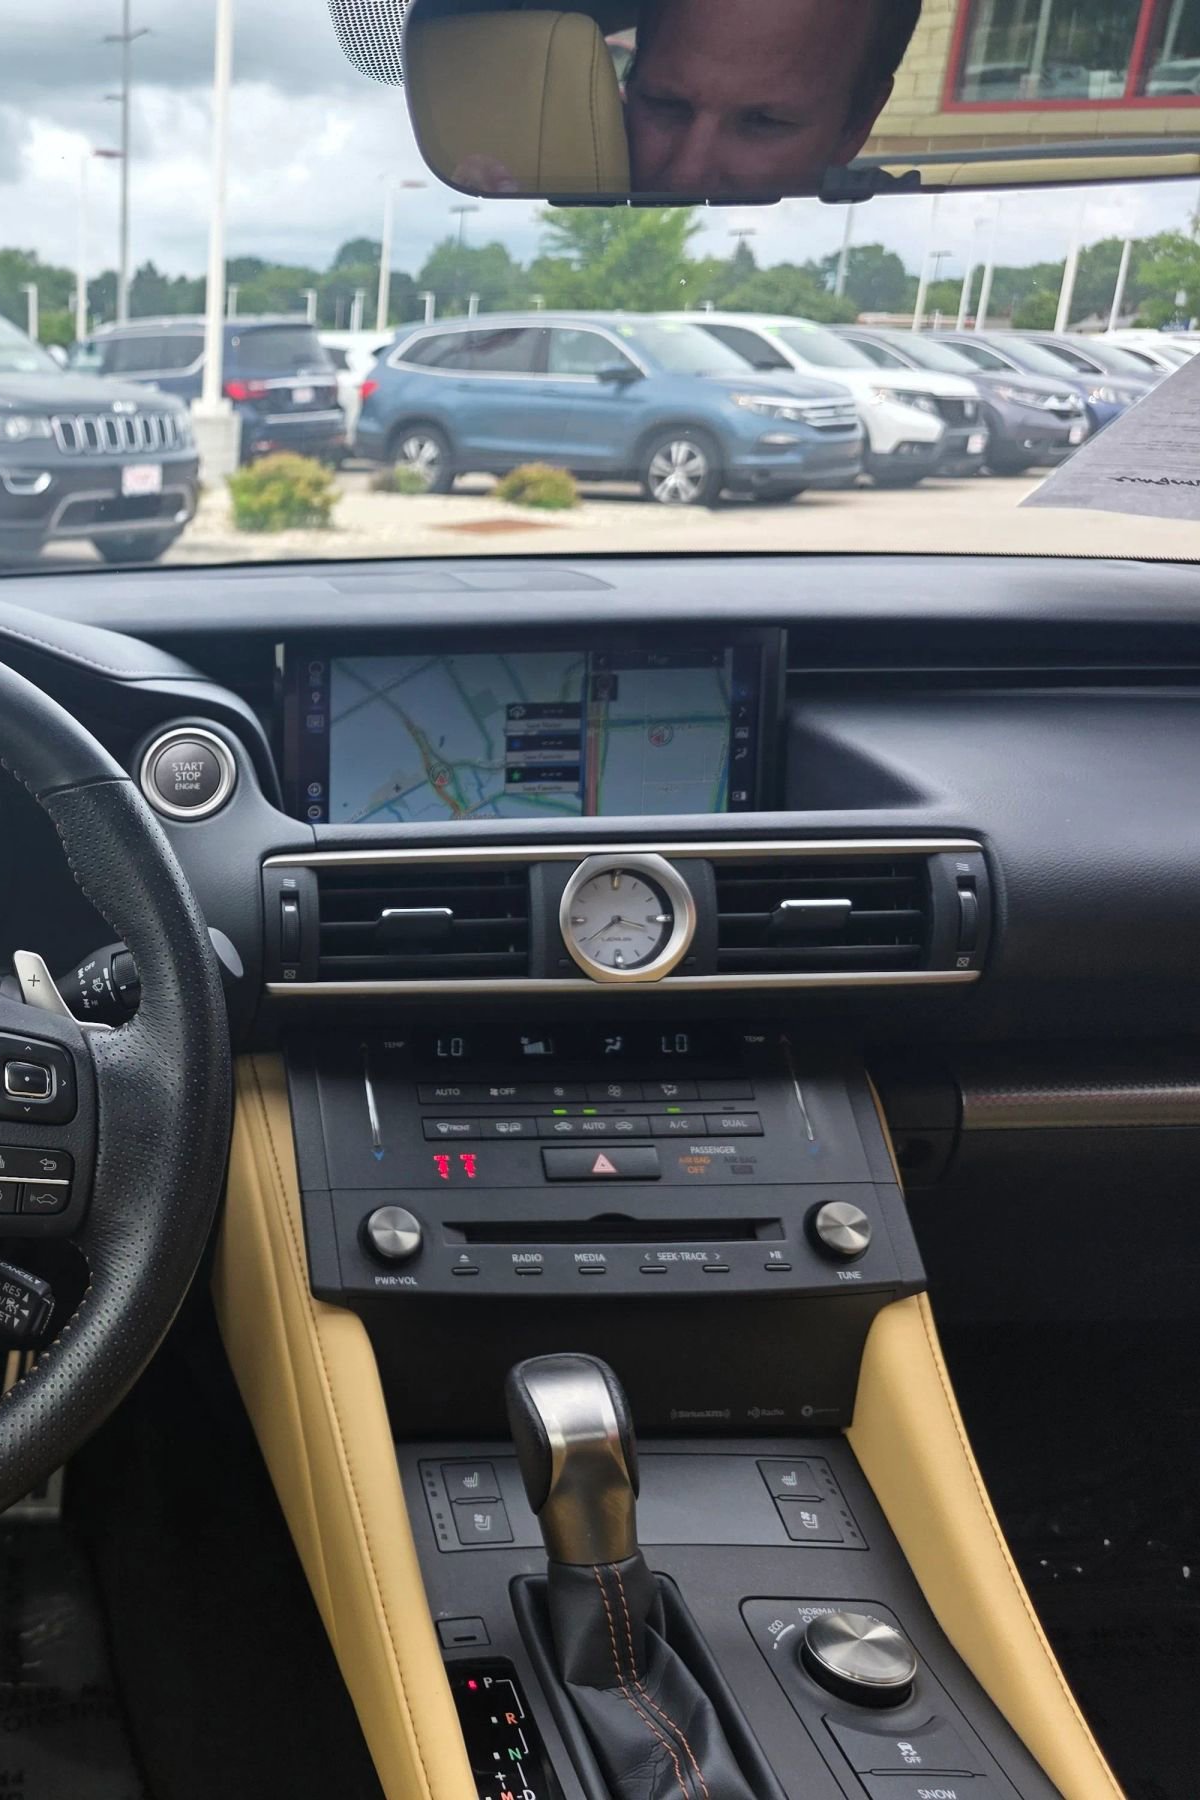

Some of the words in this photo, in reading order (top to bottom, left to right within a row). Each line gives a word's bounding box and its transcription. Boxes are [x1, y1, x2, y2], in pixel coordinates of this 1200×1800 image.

[172, 762, 204, 772] START
[175, 772, 201, 781] STOP
[437, 1038, 464, 1056] LO
[660, 1033, 688, 1053] LO
[435, 1088, 461, 1096] AUTO
[499, 1088, 517, 1096] OFF
[582, 1122, 606, 1130] AUTO
[669, 1120, 688, 1129] A/C
[721, 1120, 748, 1128] DUAL
[690, 1146, 736, 1154] PASSENGER
[512, 1254, 543, 1262] RADIO
[574, 1254, 606, 1262] MEDIA
[0, 1262, 34, 1282] CANCEL
[836, 1271, 862, 1280] TUNE
[767, 1618, 785, 1635] ECO
[483, 1676, 494, 1689] P
[505, 1712, 518, 1725] R
[508, 1747, 522, 1761] N
[904, 1756, 922, 1764] OFF
[917, 1788, 957, 1800] SNOW
